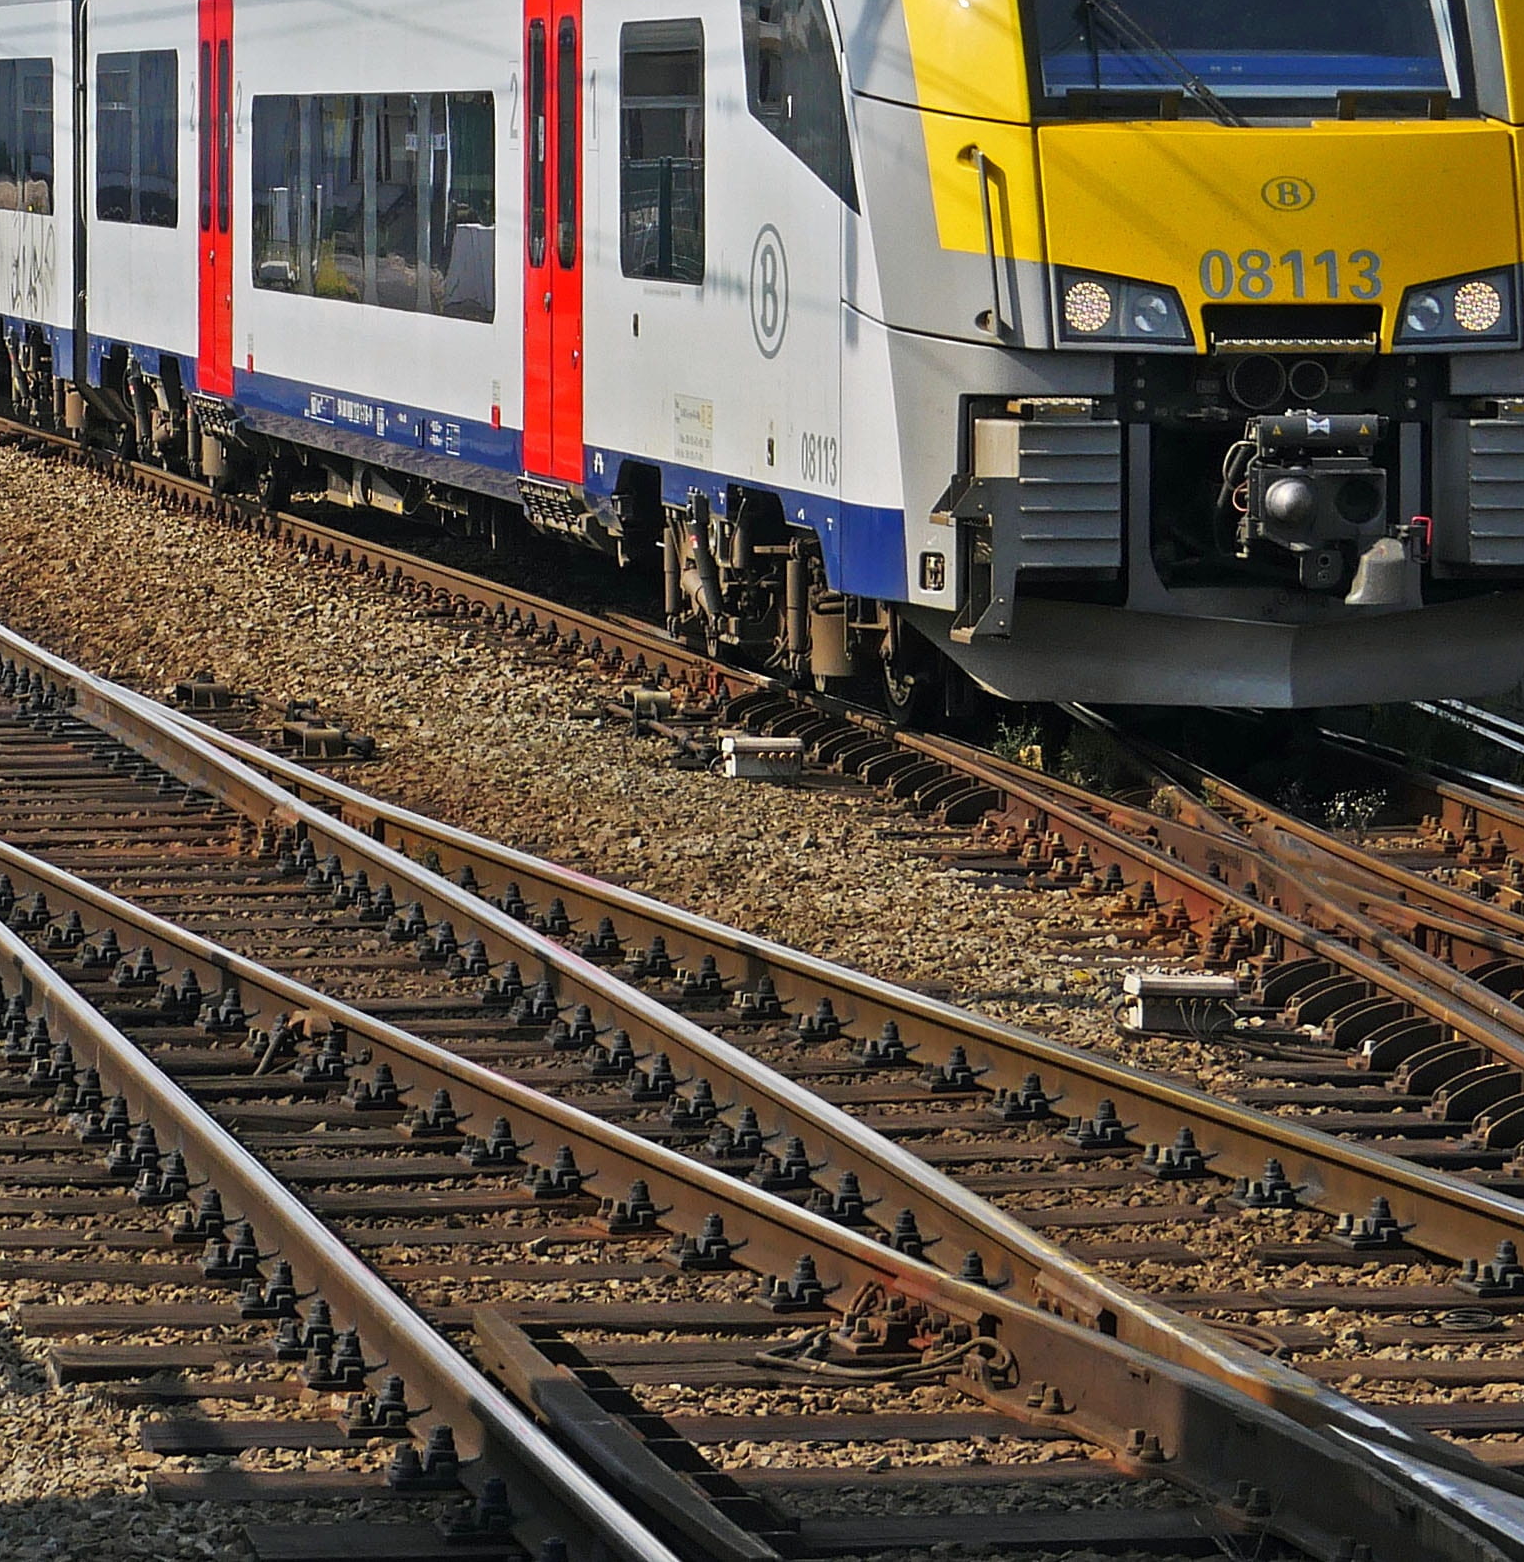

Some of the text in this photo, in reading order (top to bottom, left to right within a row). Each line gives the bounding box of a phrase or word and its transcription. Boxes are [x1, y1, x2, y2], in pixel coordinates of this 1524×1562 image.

[236, 80, 243, 135] 2
[509, 72, 519, 140] 2
[589, 68, 597, 140] 1
[1276, 181, 1302, 206] B
[760, 243, 778, 338] B
[1199, 248, 1383, 300] 08113
[801, 430, 838, 487] 08113
